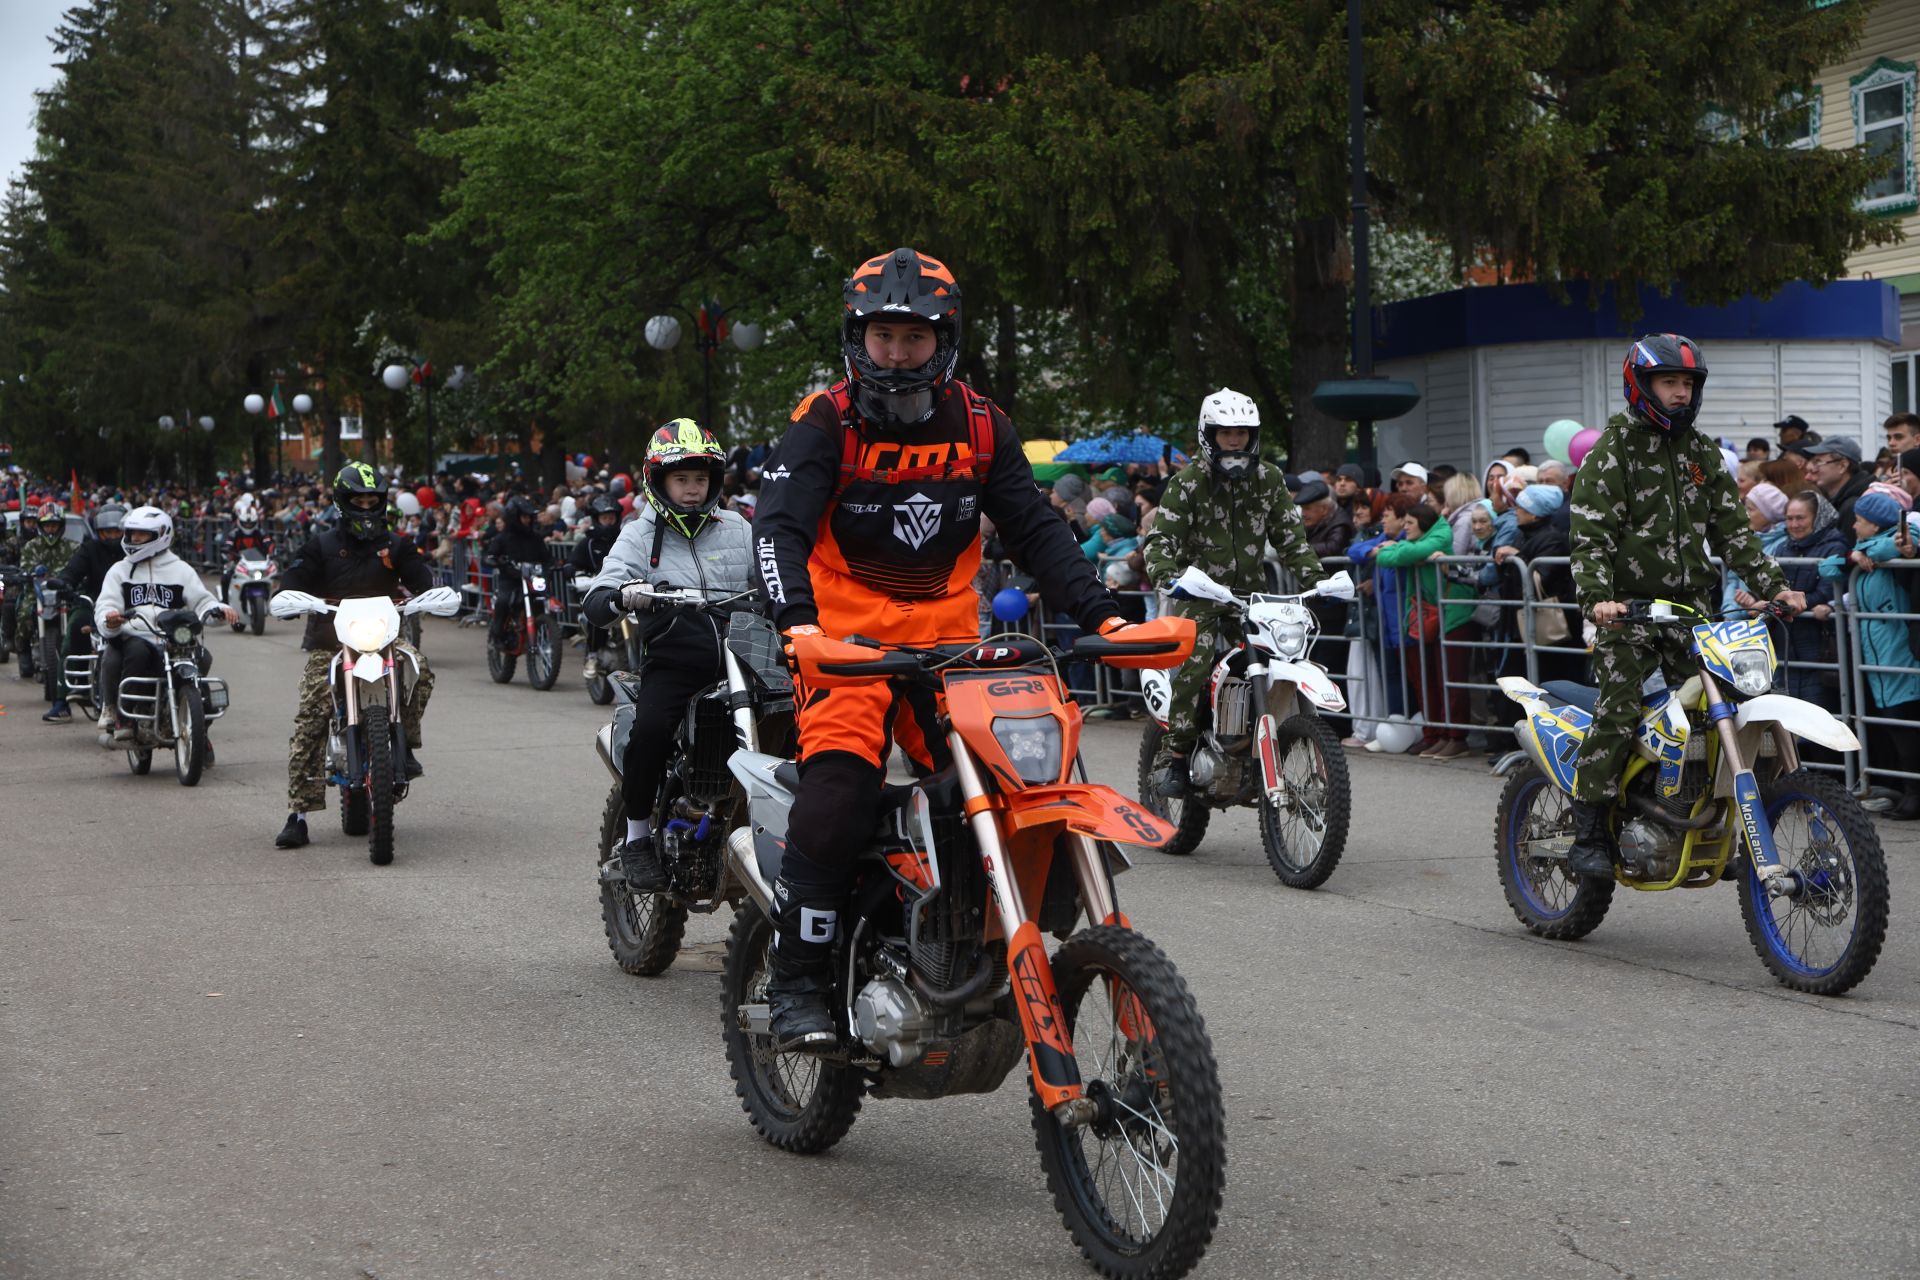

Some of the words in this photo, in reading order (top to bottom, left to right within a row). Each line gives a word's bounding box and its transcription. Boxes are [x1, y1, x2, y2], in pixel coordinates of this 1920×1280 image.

[130, 584, 174, 608] GAP
[987, 680, 1045, 697] GR8
[1114, 805, 1163, 842] GR8
[800, 906, 837, 944] G
